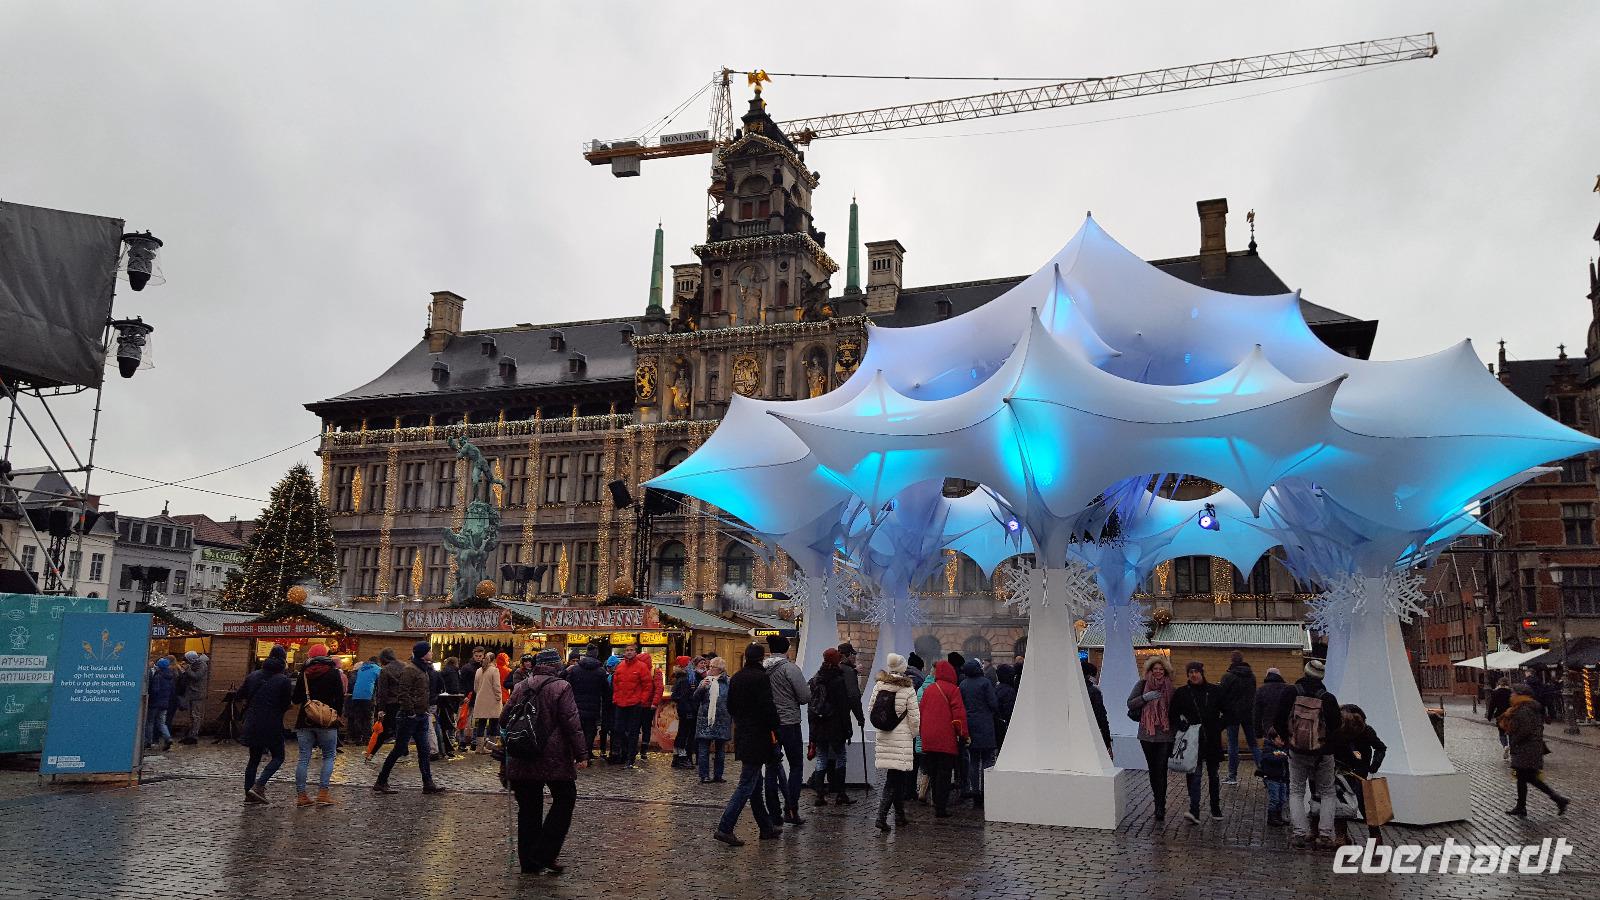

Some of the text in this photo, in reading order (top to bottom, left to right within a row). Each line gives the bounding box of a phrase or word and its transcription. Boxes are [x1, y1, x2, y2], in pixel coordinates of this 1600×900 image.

[661, 131, 709, 143] MONUMENT
[545, 608, 645, 627] TARTIFLETTE
[1, 657, 45, 666] ATYPISCH
